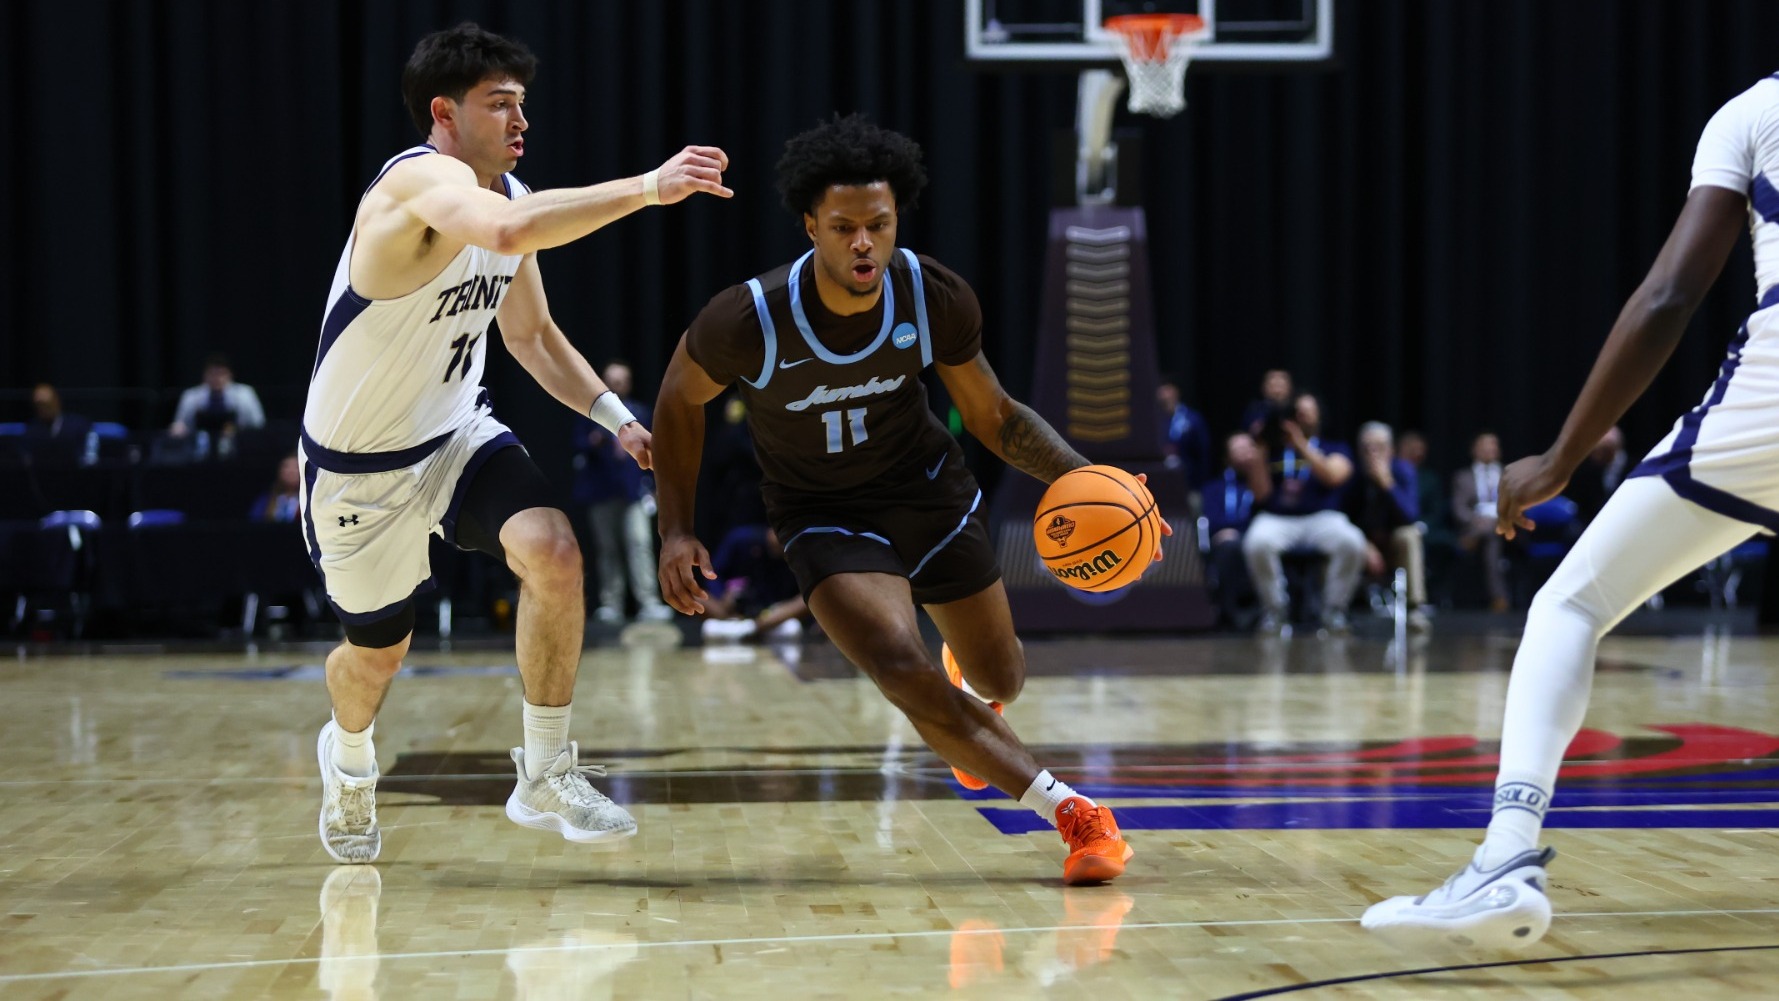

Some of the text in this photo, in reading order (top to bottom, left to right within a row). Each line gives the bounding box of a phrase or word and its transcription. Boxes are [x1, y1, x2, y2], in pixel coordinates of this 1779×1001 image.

[896, 333, 916, 345] NCAA
[785, 375, 906, 411] Jumbos
[822, 407, 869, 453] 11
[1048, 549, 1122, 580] Wilson
